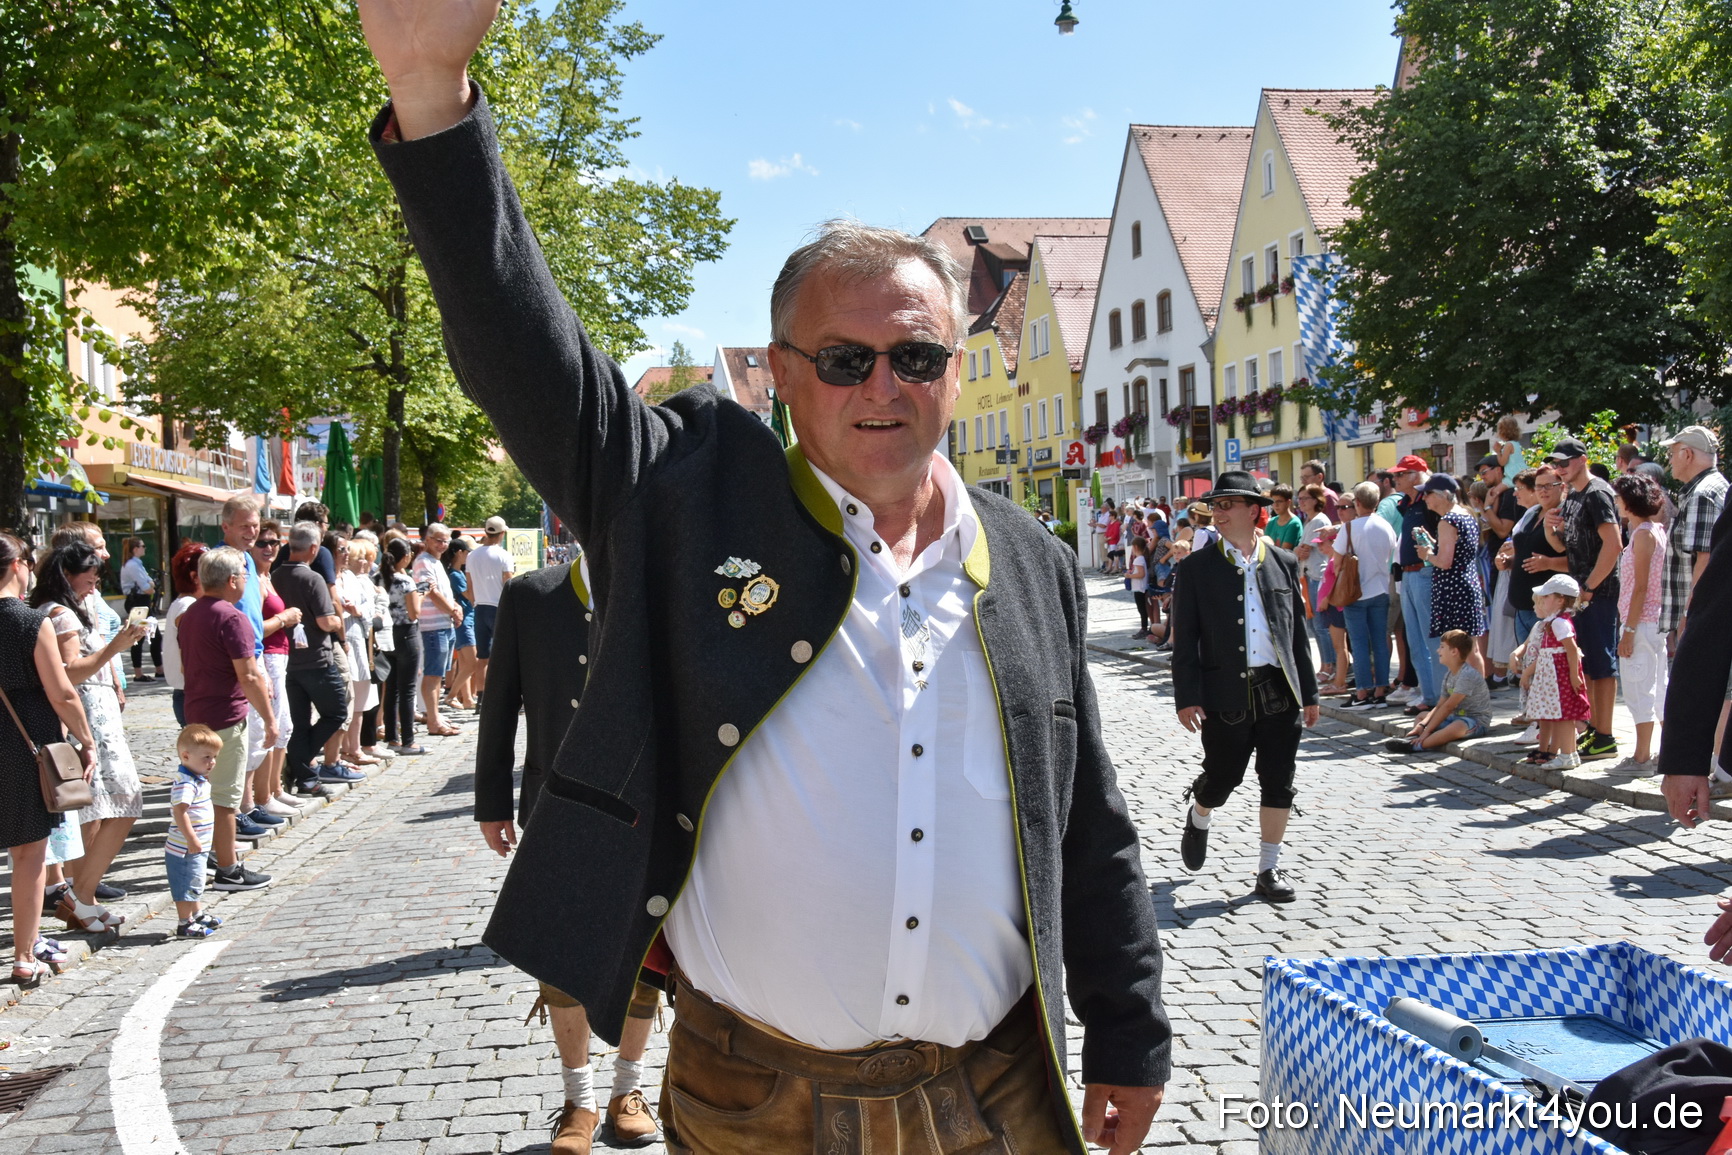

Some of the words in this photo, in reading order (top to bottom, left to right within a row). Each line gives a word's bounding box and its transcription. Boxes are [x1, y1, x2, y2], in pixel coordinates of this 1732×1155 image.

[978, 395, 993, 410] HOTEL
[132, 443, 151, 468] LEDER
[1228, 442, 1237, 460] P
[978, 465, 1000, 477] Restaurant
